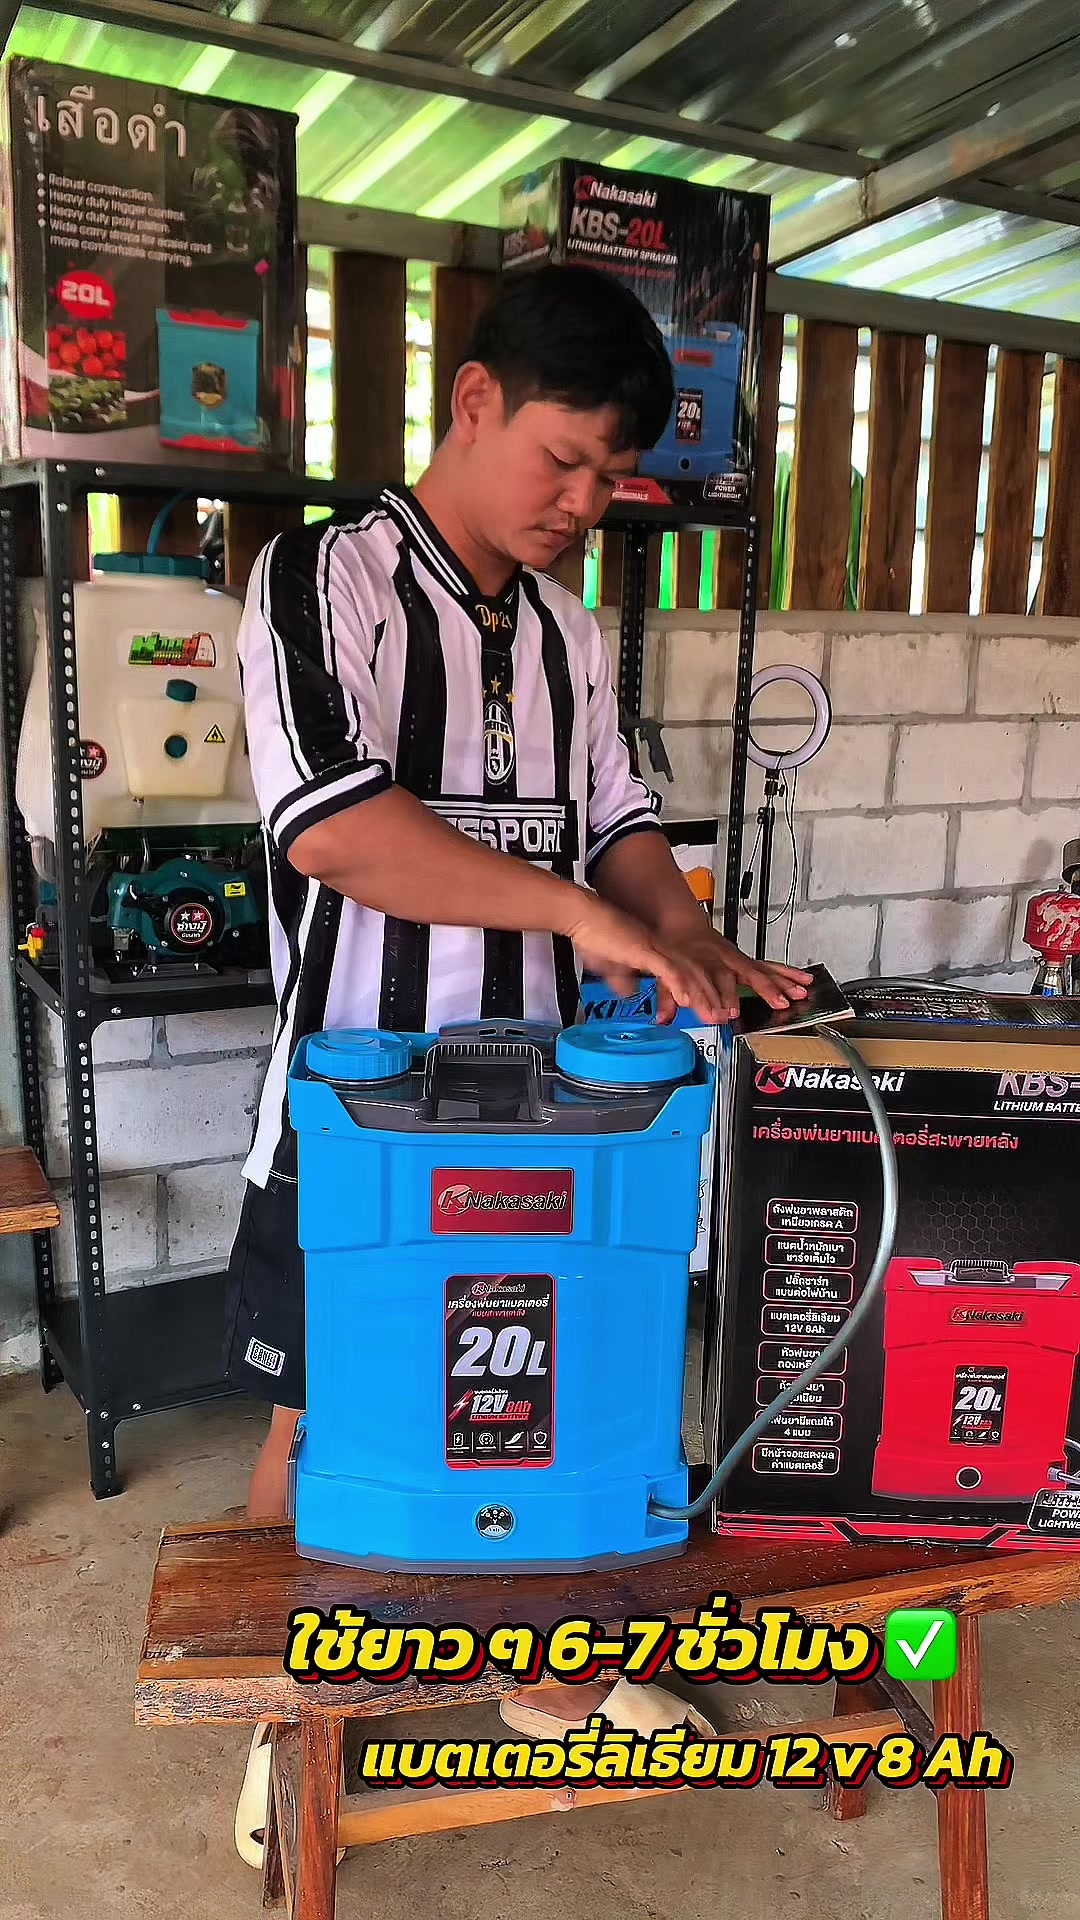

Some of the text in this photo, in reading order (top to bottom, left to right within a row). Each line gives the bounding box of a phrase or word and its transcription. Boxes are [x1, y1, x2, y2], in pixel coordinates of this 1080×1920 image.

[37, 84, 187, 157] เสือดำ
[570, 206, 670, 252] KBS-20L
[567, 238, 679, 265] LITHIUM BATTERY SPRAYER
[61, 279, 111, 307] 20L
[993, 1101, 1044, 1112] LITHIUM
[834, 1220, 844, 1229] A
[784, 1324, 804, 1333] 12V
[450, 1326, 548, 1377] 20L
[471, 1393, 532, 1413] 12V 8Ah
[954, 1385, 1002, 1412] 20L
[784, 1428, 812, 1437] 4 แบบ
